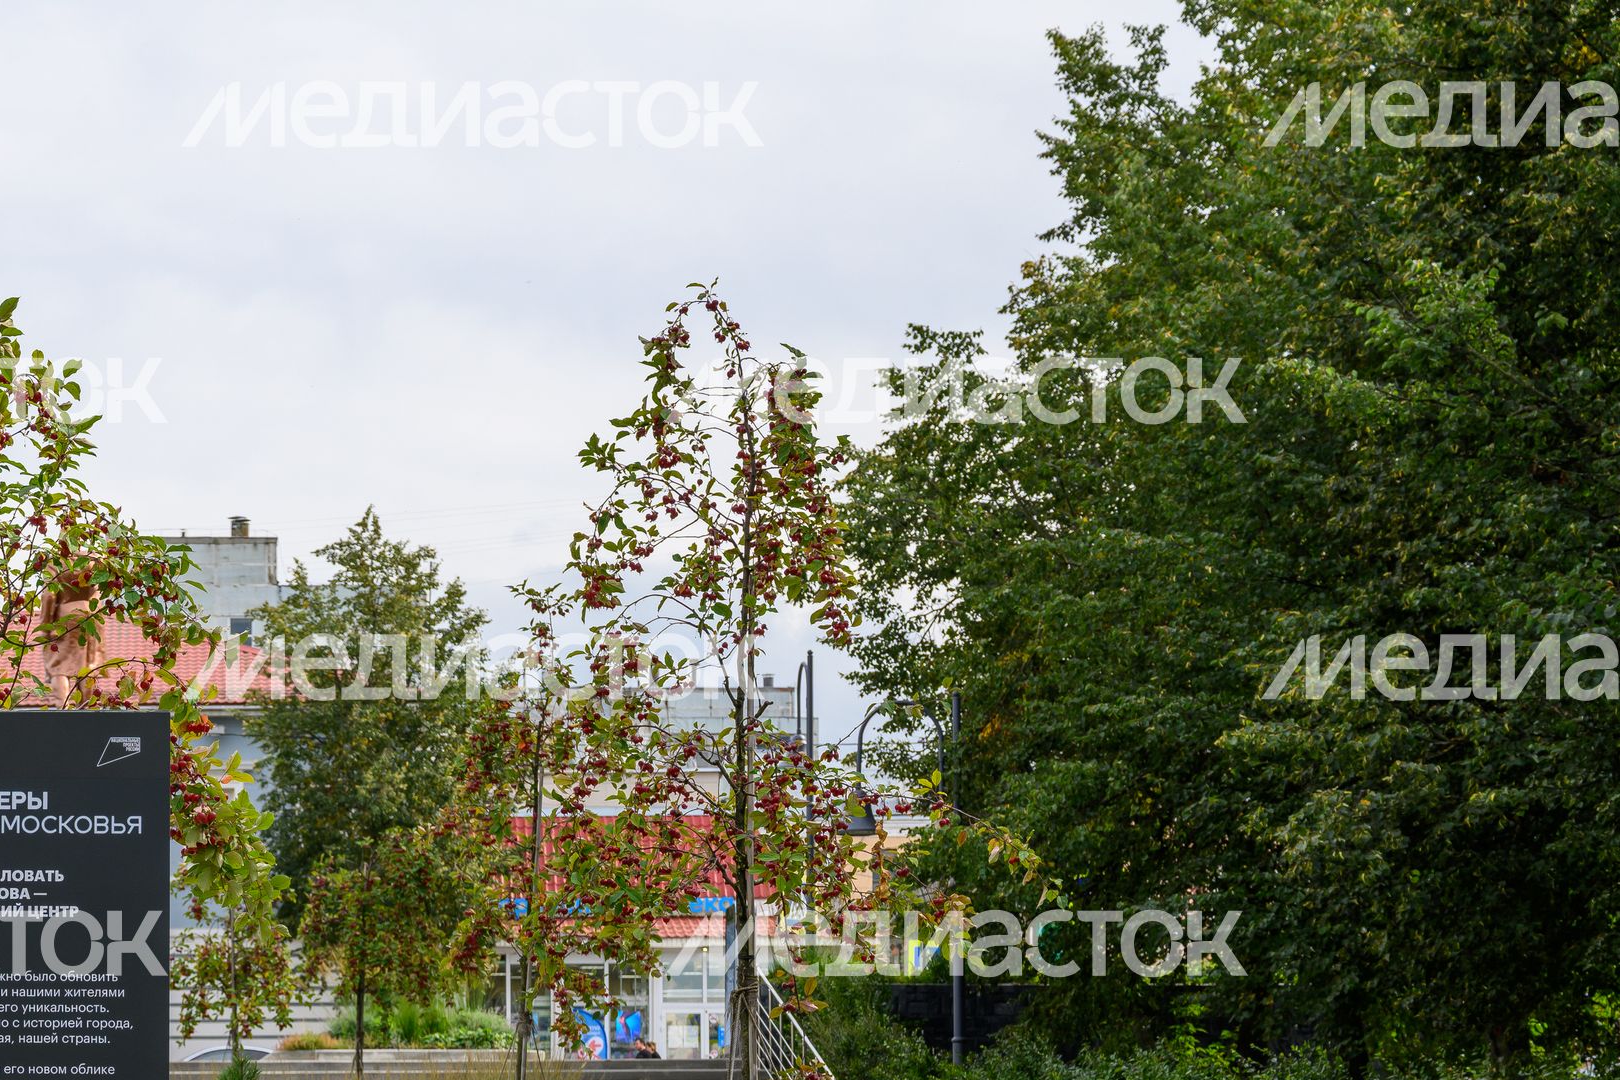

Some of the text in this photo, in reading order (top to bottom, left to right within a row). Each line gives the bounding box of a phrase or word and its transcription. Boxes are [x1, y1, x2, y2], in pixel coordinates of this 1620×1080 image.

[27, 905, 80, 920] ЦЕНТР
[24, 970, 57, 982] было
[60, 969, 118, 982] обновить
[11, 988, 61, 998] нашими
[63, 988, 125, 998] жителями
[21, 1003, 110, 1015] уникальность.
[12, 1019, 20, 1028] с
[23, 1016, 83, 1031] историей
[86, 1019, 134, 1031] города,
[18, 1032, 59, 1044] нашей
[61, 1034, 111, 1046] страны.
[3, 1065, 25, 1075] его
[28, 1065, 67, 1075] новом
[70, 1062, 116, 1075] облике
